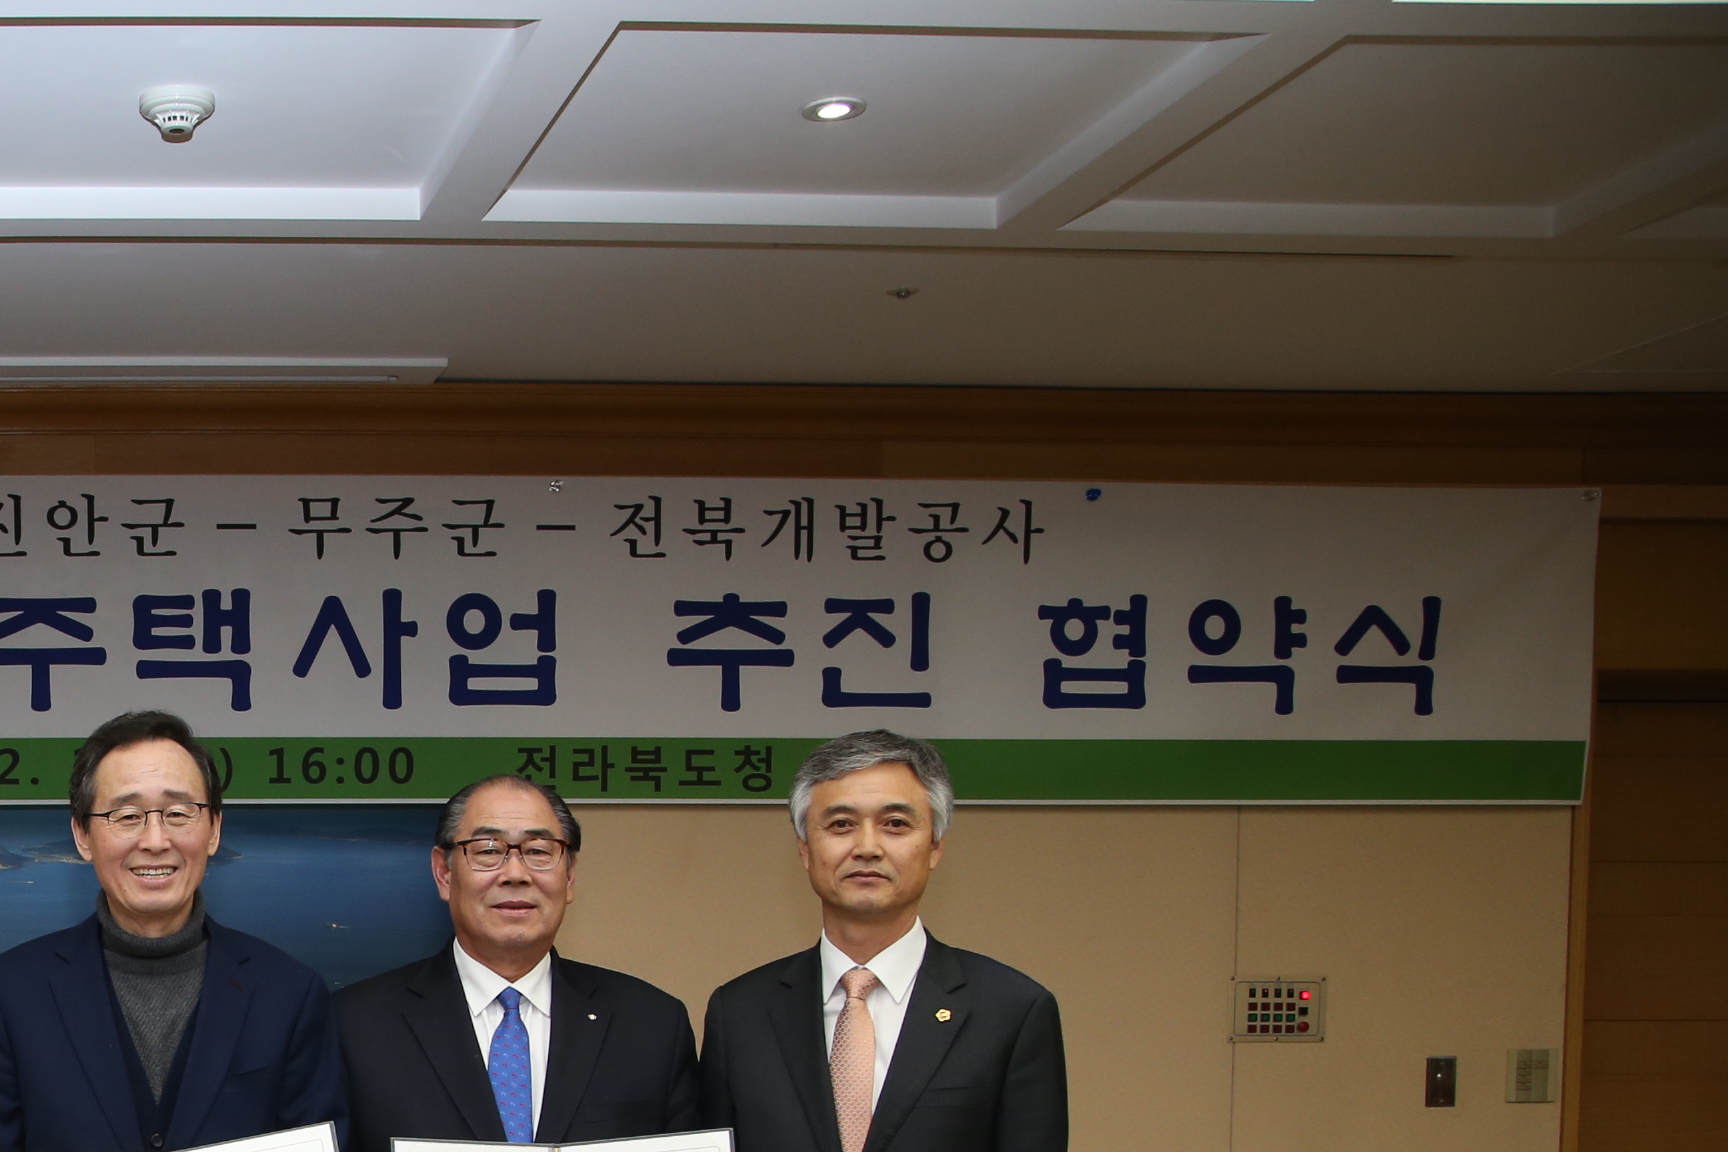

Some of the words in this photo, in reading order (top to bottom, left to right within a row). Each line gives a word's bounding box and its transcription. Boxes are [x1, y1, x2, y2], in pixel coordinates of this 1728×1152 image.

[288, 497, 505, 560] 무주군
[610, 496, 1044, 564] 전북개발공사
[667, 592, 931, 712] 추진
[1038, 594, 1441, 716] 협약식
[269, 746, 415, 785] 16:00
[515, 744, 773, 794] 전라북도청
